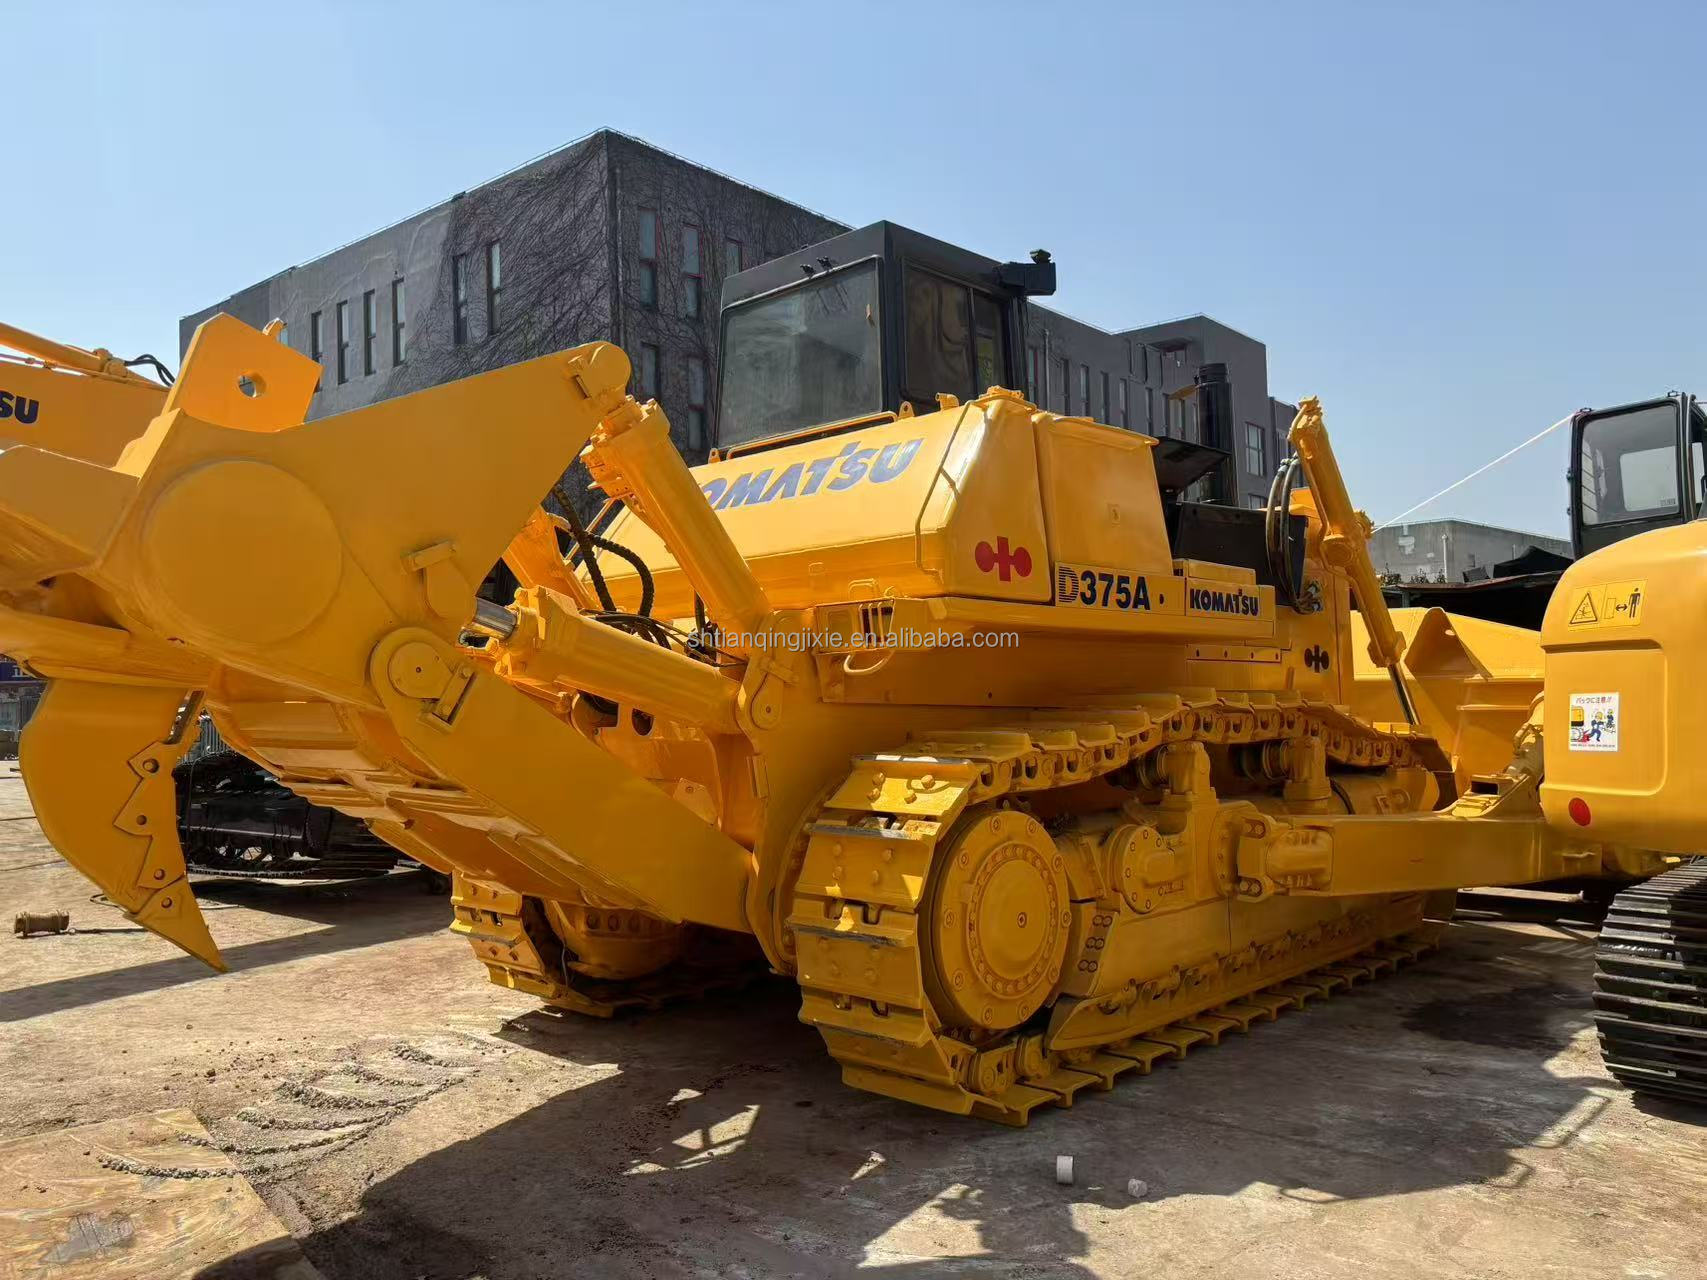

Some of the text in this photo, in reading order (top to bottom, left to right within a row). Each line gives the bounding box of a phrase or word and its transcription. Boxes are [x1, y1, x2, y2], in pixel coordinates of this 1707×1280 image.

[701, 438, 924, 511] OMATSU
[1058, 565, 1151, 611] D375A
[1189, 587, 1260, 617] KOMATSU
